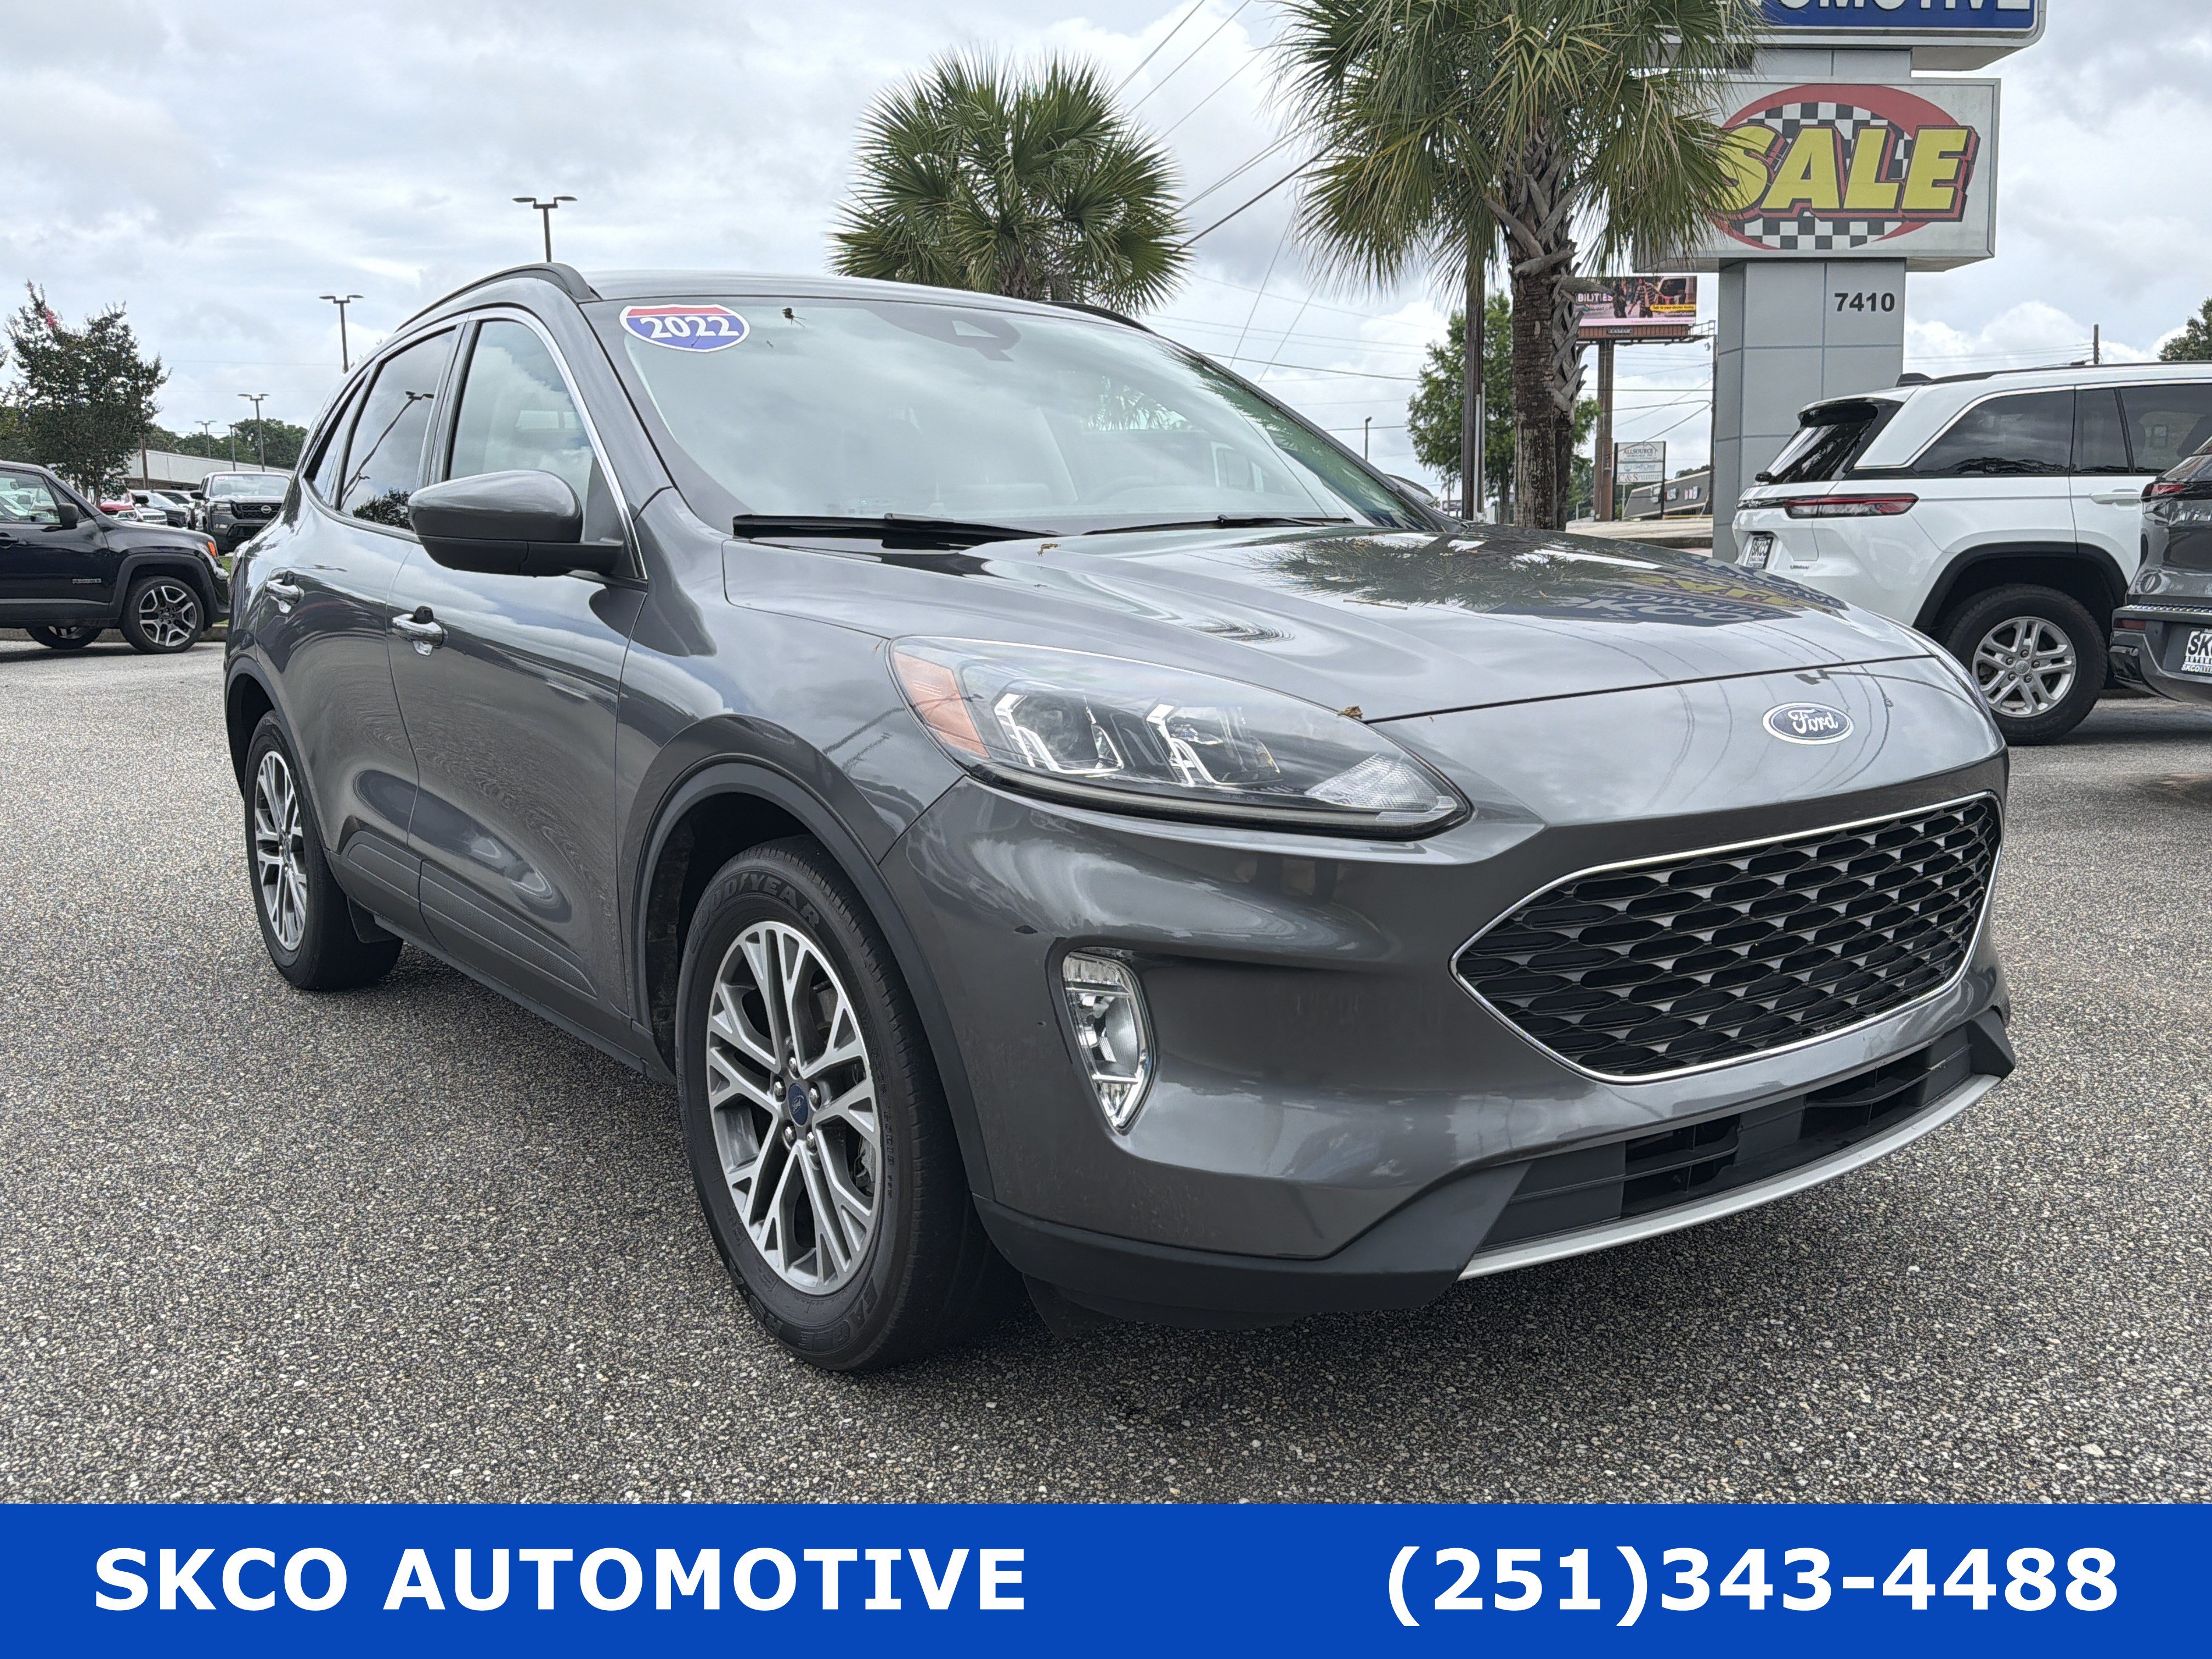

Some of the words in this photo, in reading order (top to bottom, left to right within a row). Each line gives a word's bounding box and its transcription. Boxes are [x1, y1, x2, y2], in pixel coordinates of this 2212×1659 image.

[1713, 125, 1978, 221] SALE
[1834, 292, 1895, 312] 7410
[639, 316, 740, 338] 2022
[1618, 474, 1624, 483] C
[1633, 473, 1639, 482] S
[2188, 634, 2212, 656] SK
[1787, 709, 1838, 734] Ford
[689, 872, 820, 953] GOODYEAR
